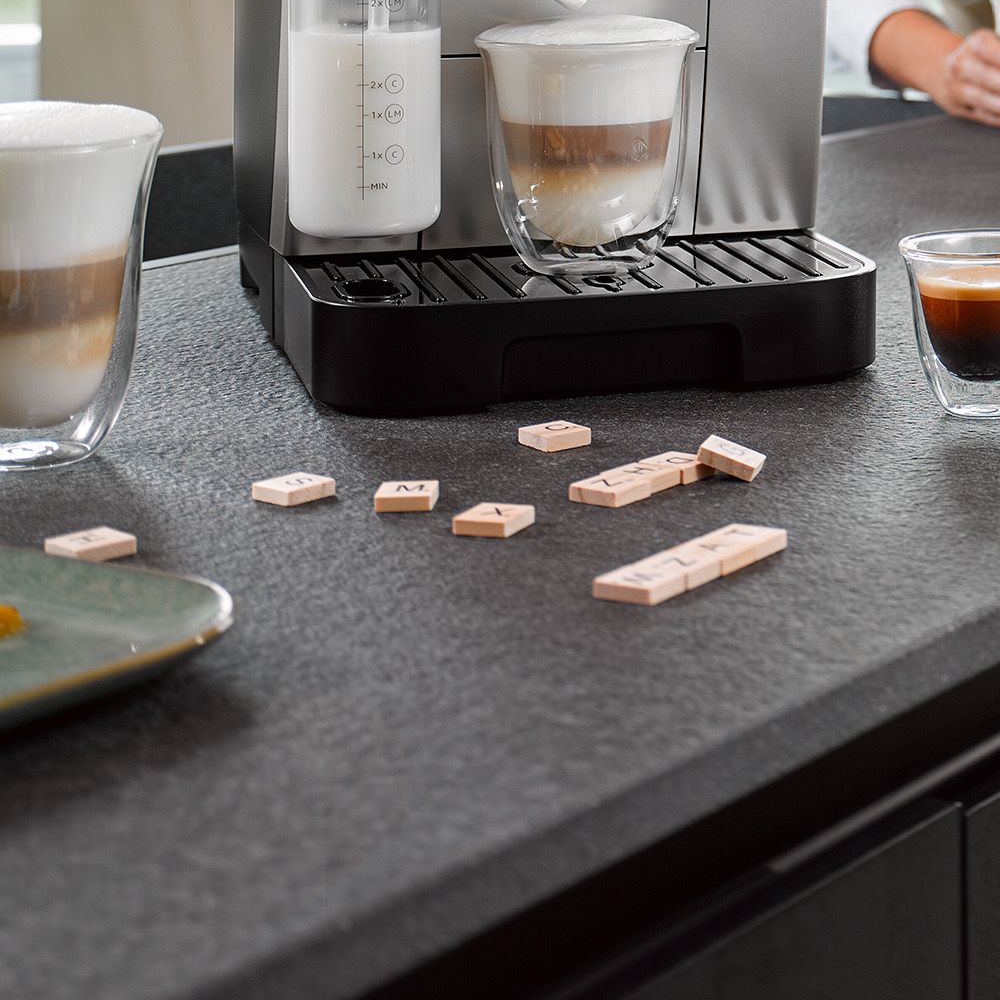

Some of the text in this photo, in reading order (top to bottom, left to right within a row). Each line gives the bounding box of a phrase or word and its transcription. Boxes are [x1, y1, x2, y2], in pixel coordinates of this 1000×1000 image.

[370, 81, 383, 89] 2x
[372, 110, 402, 119] 1x LM
[370, 182, 388, 190] MIN
[395, 484, 424, 492] M
